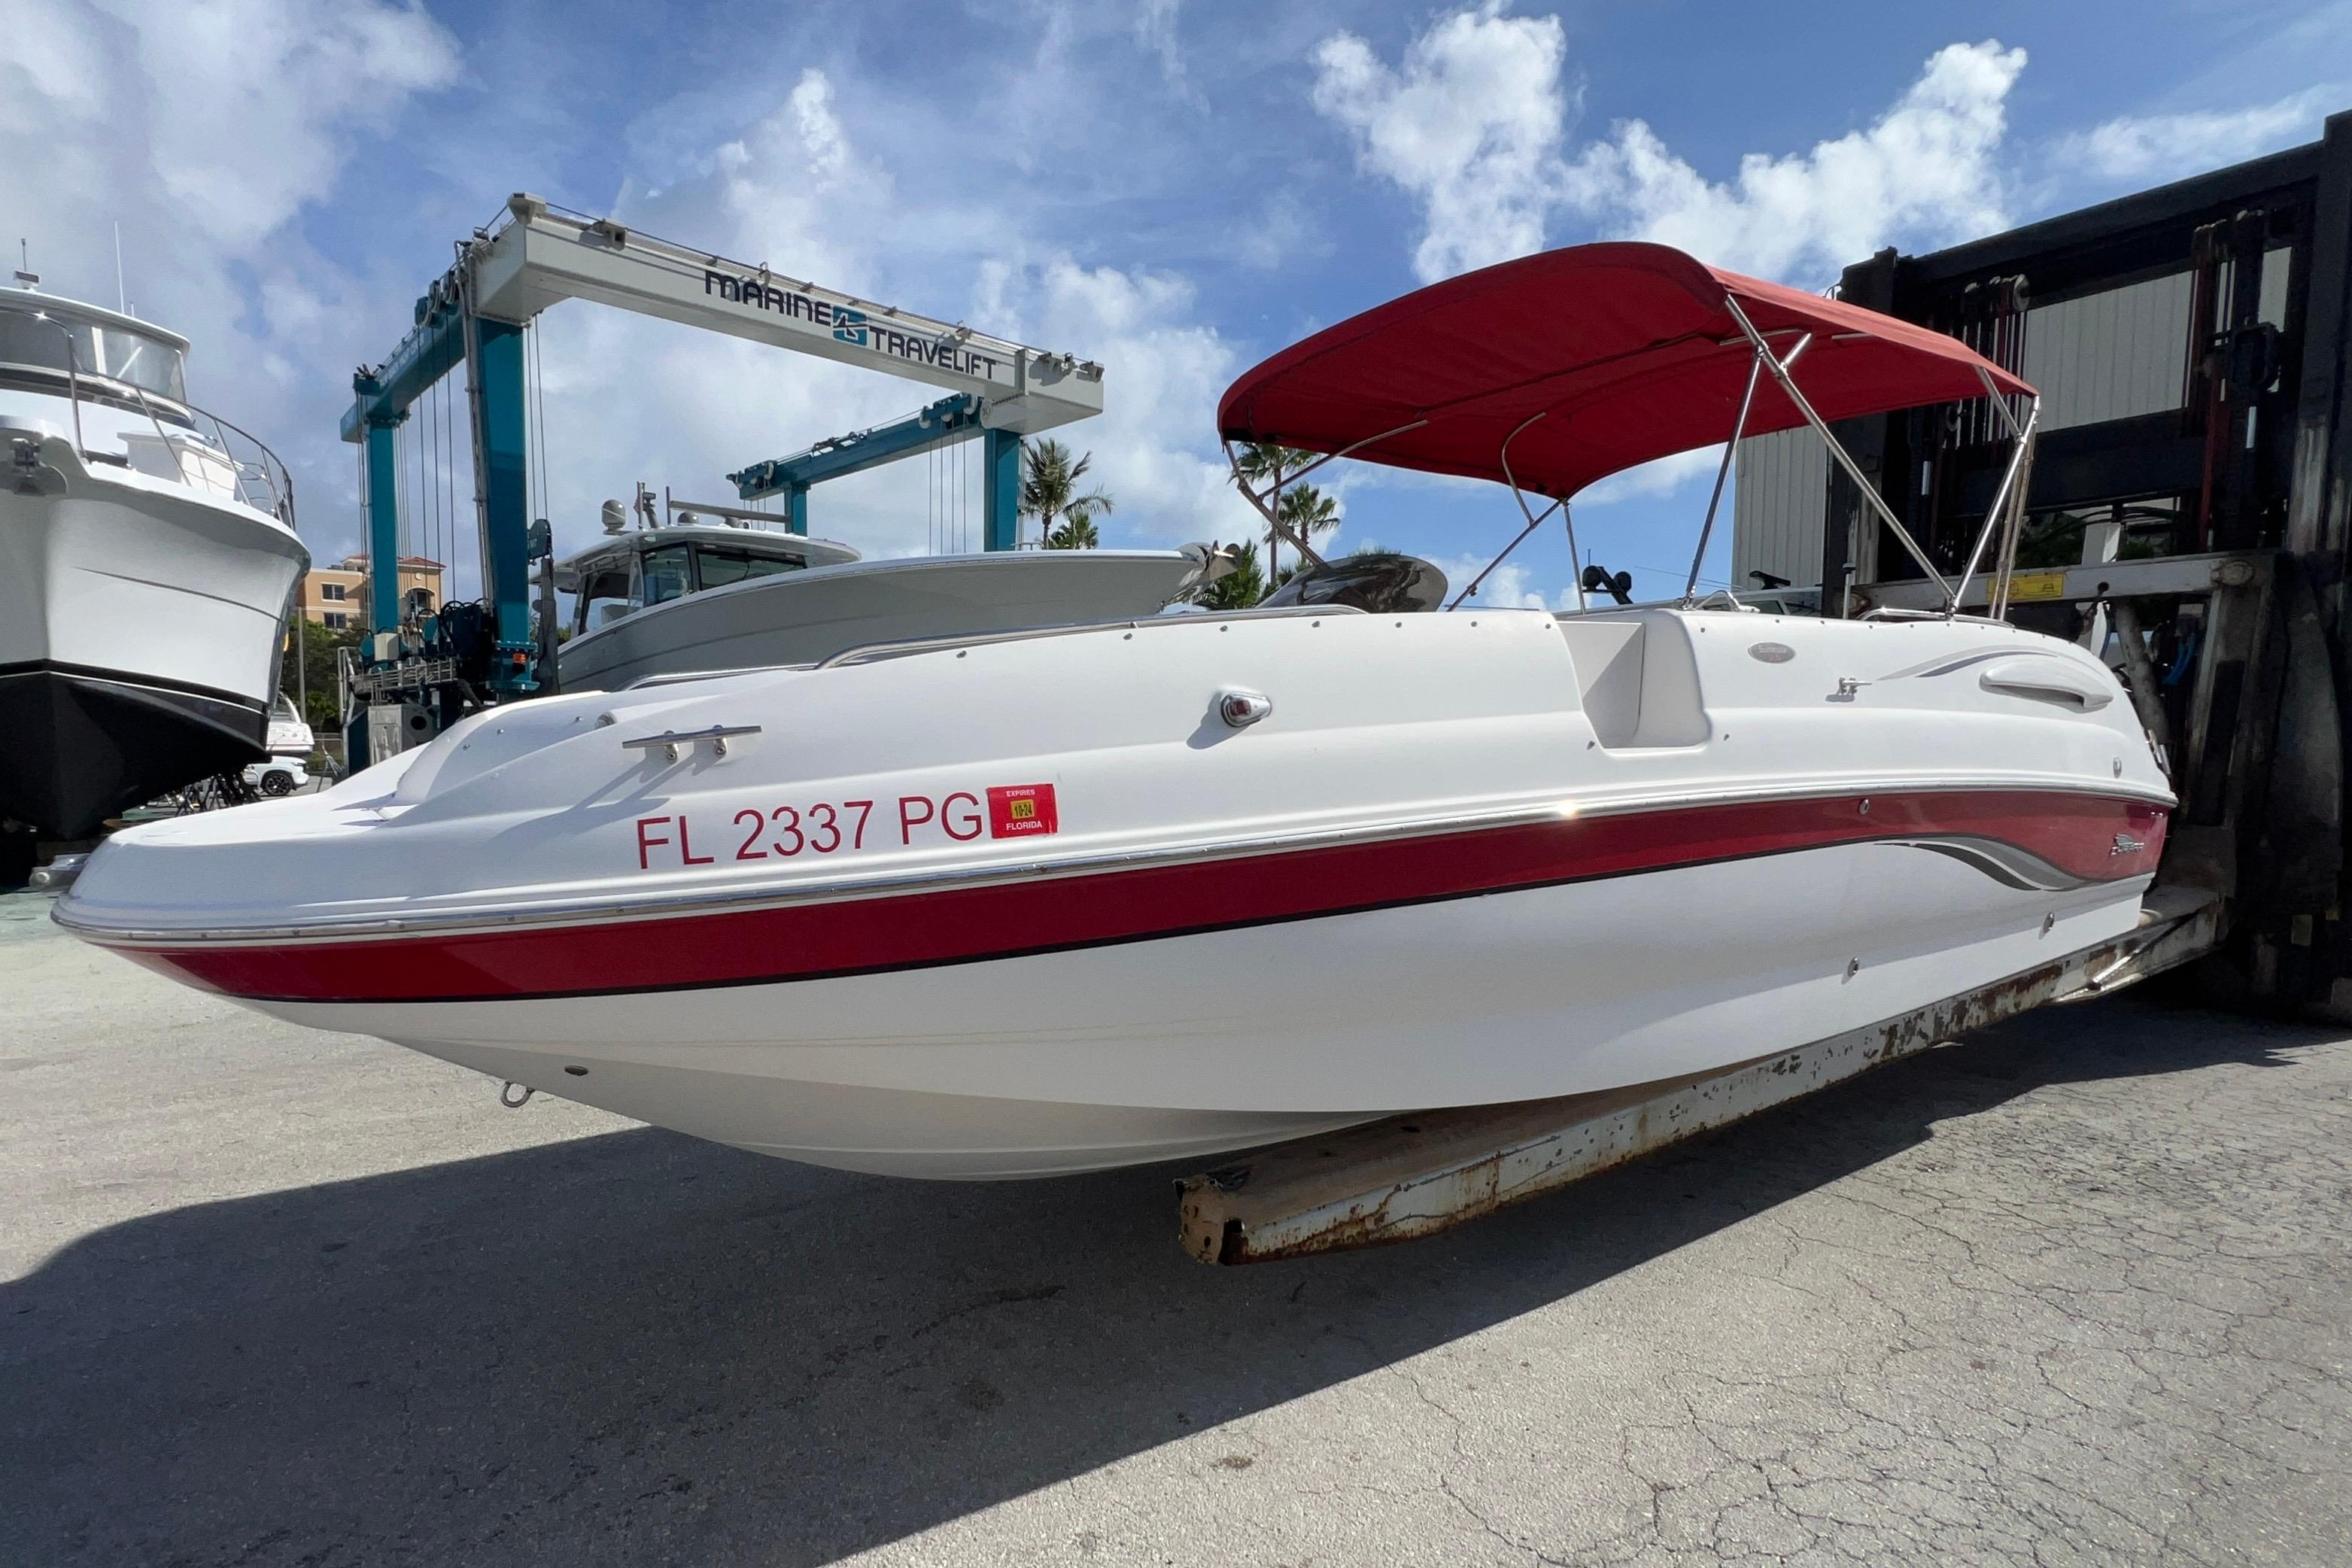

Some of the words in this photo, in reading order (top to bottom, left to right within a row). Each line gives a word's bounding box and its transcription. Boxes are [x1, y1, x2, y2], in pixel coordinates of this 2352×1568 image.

[705, 269, 831, 327] MARINE
[869, 326, 996, 379] TRAVELIFT
[1006, 789, 1035, 798] EXPIRES
[1014, 803, 1033, 818] 10-24
[637, 816, 715, 869] FL
[734, 801, 874, 860] 2337
[899, 792, 983, 844] PG
[1006, 820, 1043, 831] FLORIDA
